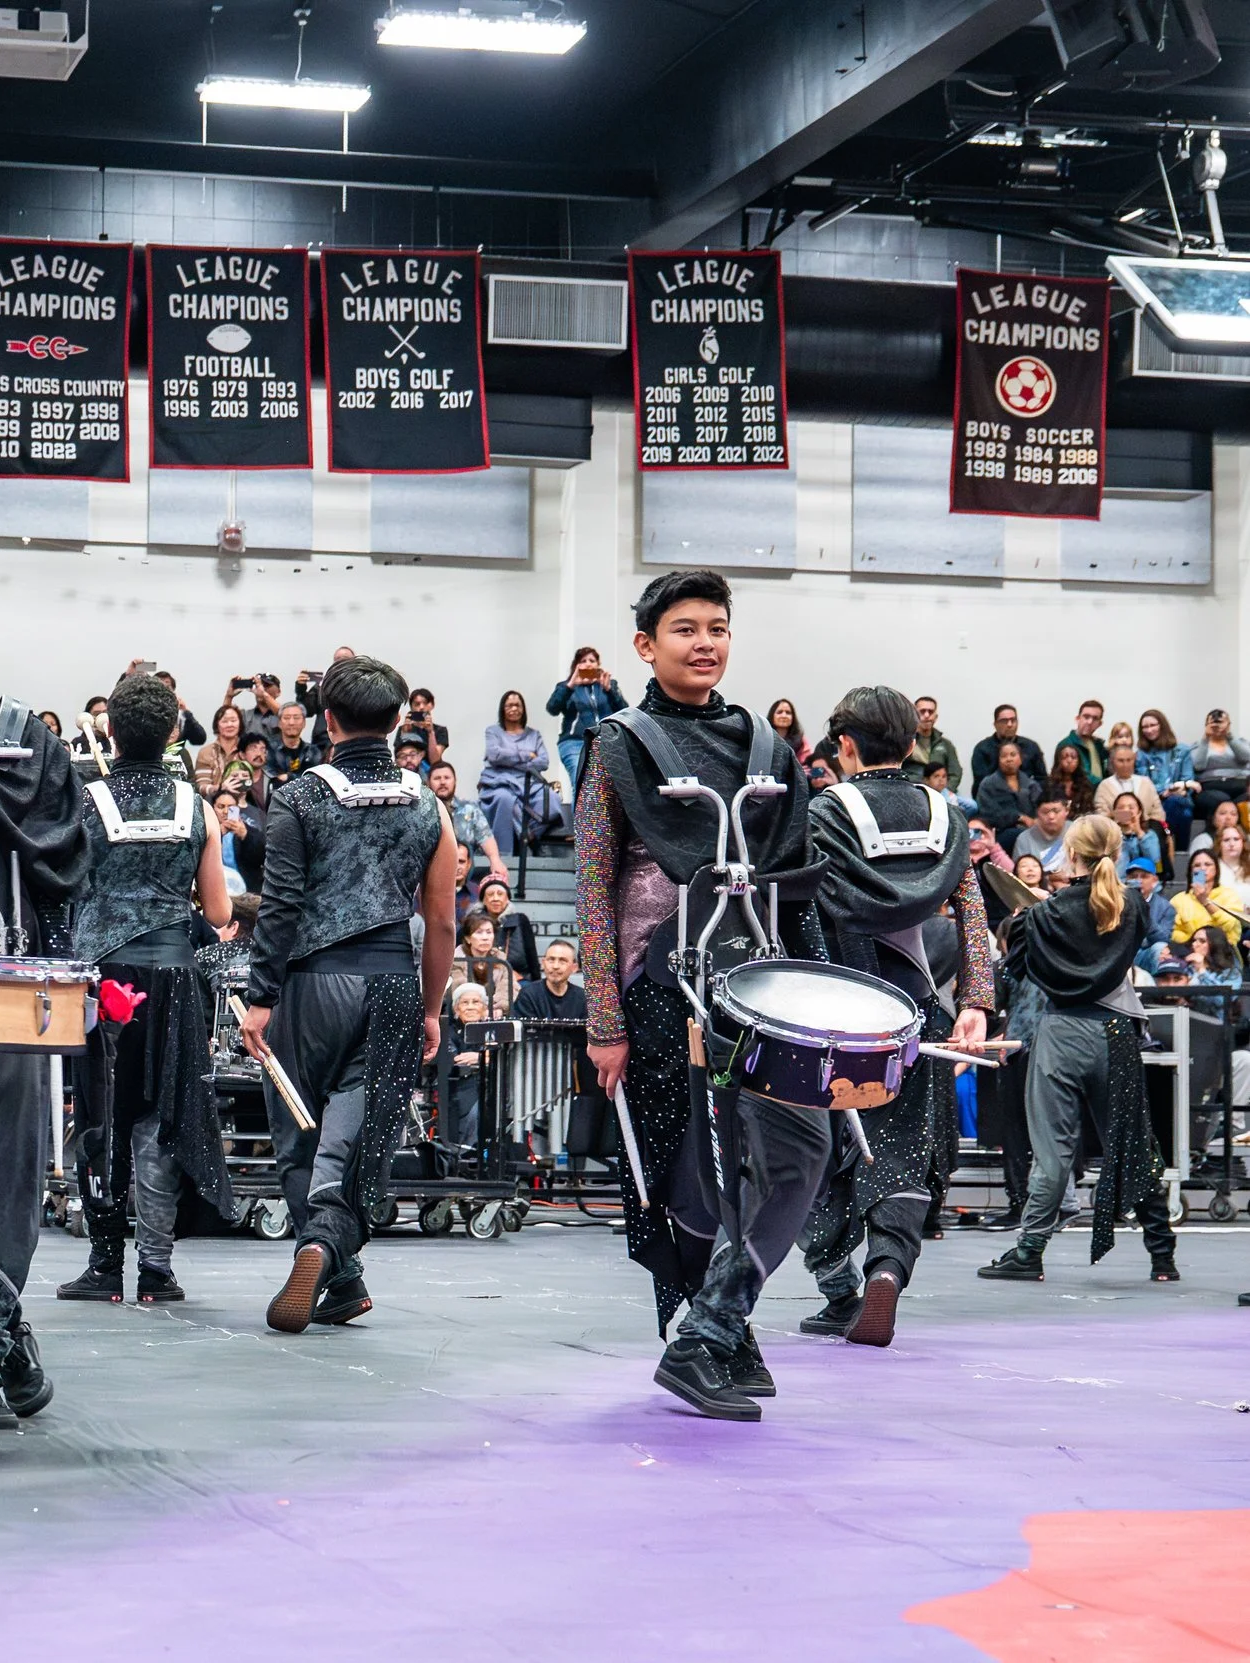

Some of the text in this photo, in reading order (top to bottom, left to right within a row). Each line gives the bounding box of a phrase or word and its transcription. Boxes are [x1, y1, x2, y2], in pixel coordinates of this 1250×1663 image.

[176, 256, 280, 291] LEAGUE
[340, 259, 462, 294] LEAGUE
[657, 260, 755, 293] LEAGUE
[168, 294, 289, 321] CHAMPIONS
[342, 297, 462, 323] CHAMPIONS
[651, 299, 764, 323] CHAMPIONS
[971, 282, 1088, 323] LEAGUE
[964, 319, 1101, 352] CHAMPIONS
[184, 356, 276, 378] FOOTBALL
[664, 367, 755, 384] GIRLS GOLF
[14, 377, 60, 395] CROSS
[63, 380, 126, 397] COUNTRY
[162, 379, 297, 398] 1976 1979 1993
[355, 368, 454, 390] BOYS GOLF
[338, 390, 474, 409] 2002 2016 2017
[645, 386, 775, 403] 2006 2009 2010
[32, 401, 75, 420] 1997
[80, 403, 119, 420] 1998
[163, 400, 299, 418] 1996 2003 2006
[646, 406, 776, 423] 2011 2012 2015
[31, 422, 75, 440] 2007
[79, 423, 120, 440] 2008
[647, 426, 777, 443] 2016 2017 2018
[965, 421, 1095, 445] BOYS SOCCER
[30, 443, 77, 460] 2022
[642, 446, 784, 462] 2019 2020 2021 2022
[964, 460, 1006, 479] 1998
[1057, 468, 1098, 484] 2006
